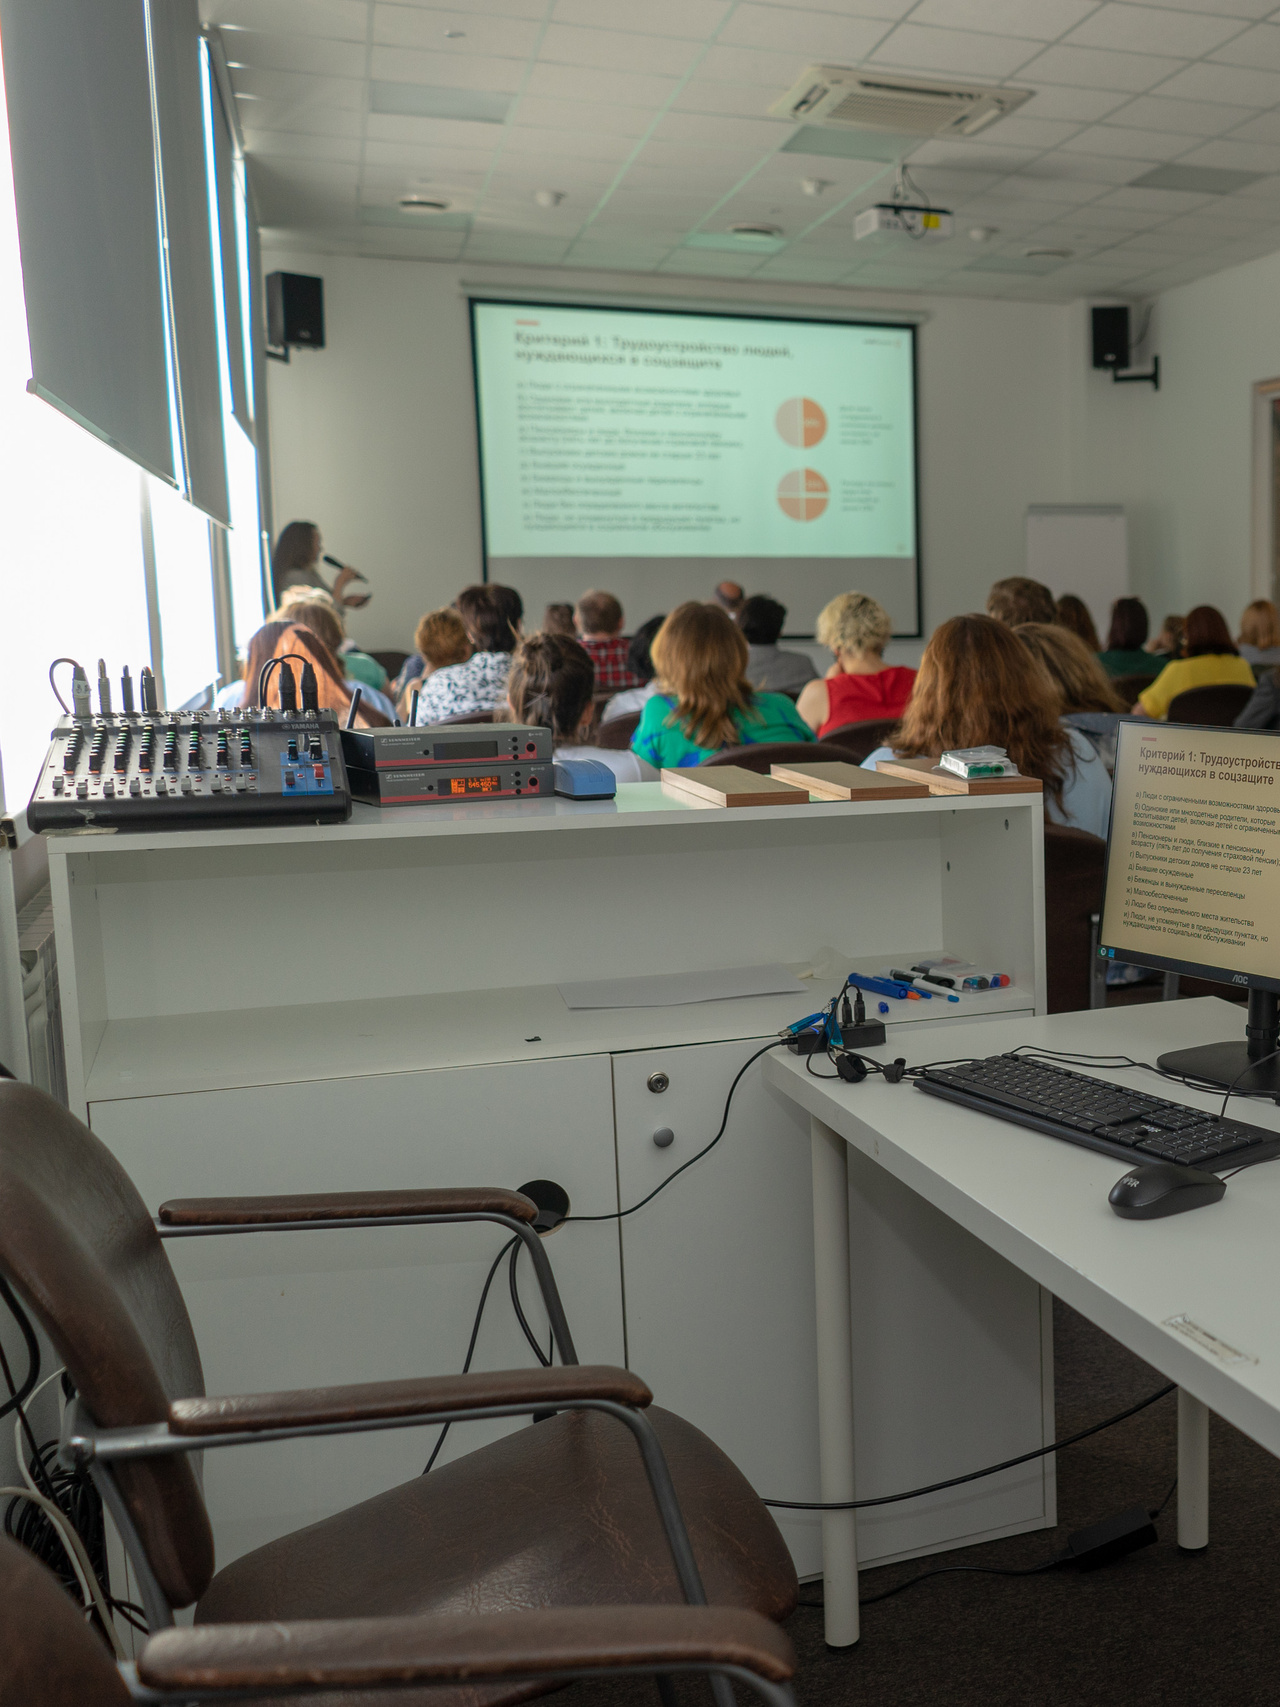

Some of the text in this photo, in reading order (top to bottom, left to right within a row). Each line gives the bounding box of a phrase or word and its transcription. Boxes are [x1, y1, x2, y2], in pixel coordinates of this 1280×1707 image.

[1140, 747, 1185, 762] Критерий
[1188, 751, 1196, 762] 1:
[1138, 762, 1274, 785] нуждающихся в соцзащите
[1136, 791, 1141, 799] а)
[1142, 791, 1157, 800] Люди
[1163, 795, 1207, 806] ограниченными
[1208, 800, 1254, 811] возможностями
[1132, 820, 1176, 830] возможностями
[1134, 803, 1140, 811] б)
[1141, 804, 1168, 814] Одинокие
[1181, 809, 1218, 819] многодетные
[1220, 814, 1249, 824] родители,
[1251, 817, 1276, 826] которые
[1134, 812, 1169, 822] воспитывают
[1170, 816, 1188, 825] детей,
[1190, 819, 1214, 827] включая
[1215, 821, 1232, 830] детей
[1131, 831, 1137, 839] в)
[1138, 831, 1173, 844] Пенсионеры
[1197, 839, 1220, 848] близкие
[1226, 844, 1265, 856] пенсионному
[1131, 840, 1155, 849] возрасту
[1156, 841, 1170, 851] (пять
[1192, 848, 1221, 858] получения
[1223, 852, 1254, 862] страховой
[1255, 856, 1280, 866] пенсии);
[1128, 863, 1194, 879] д) Бывшие осужденные
[1135, 851, 1167, 863] Выпускники
[1168, 857, 1190, 866] детских
[1191, 860, 1209, 869] домов
[1220, 865, 1241, 874] старше
[1243, 866, 1250, 874] 23
[1126, 887, 1188, 903] ж) Малообеспеченные
[1127, 875, 1246, 899] е) Беженцы вынужденные переселенцы
[1131, 900, 1254, 927] Люди без определенного места жительства
[1123, 920, 1246, 947] нуждающиеся социальном обслуживании
[1131, 911, 1147, 922] Люди,
[1156, 917, 1190, 929] упомянутые
[1196, 924, 1233, 936] предыдущих
[1234, 930, 1259, 941] пунктах,
[1232, 974, 1248, 984] AOC
